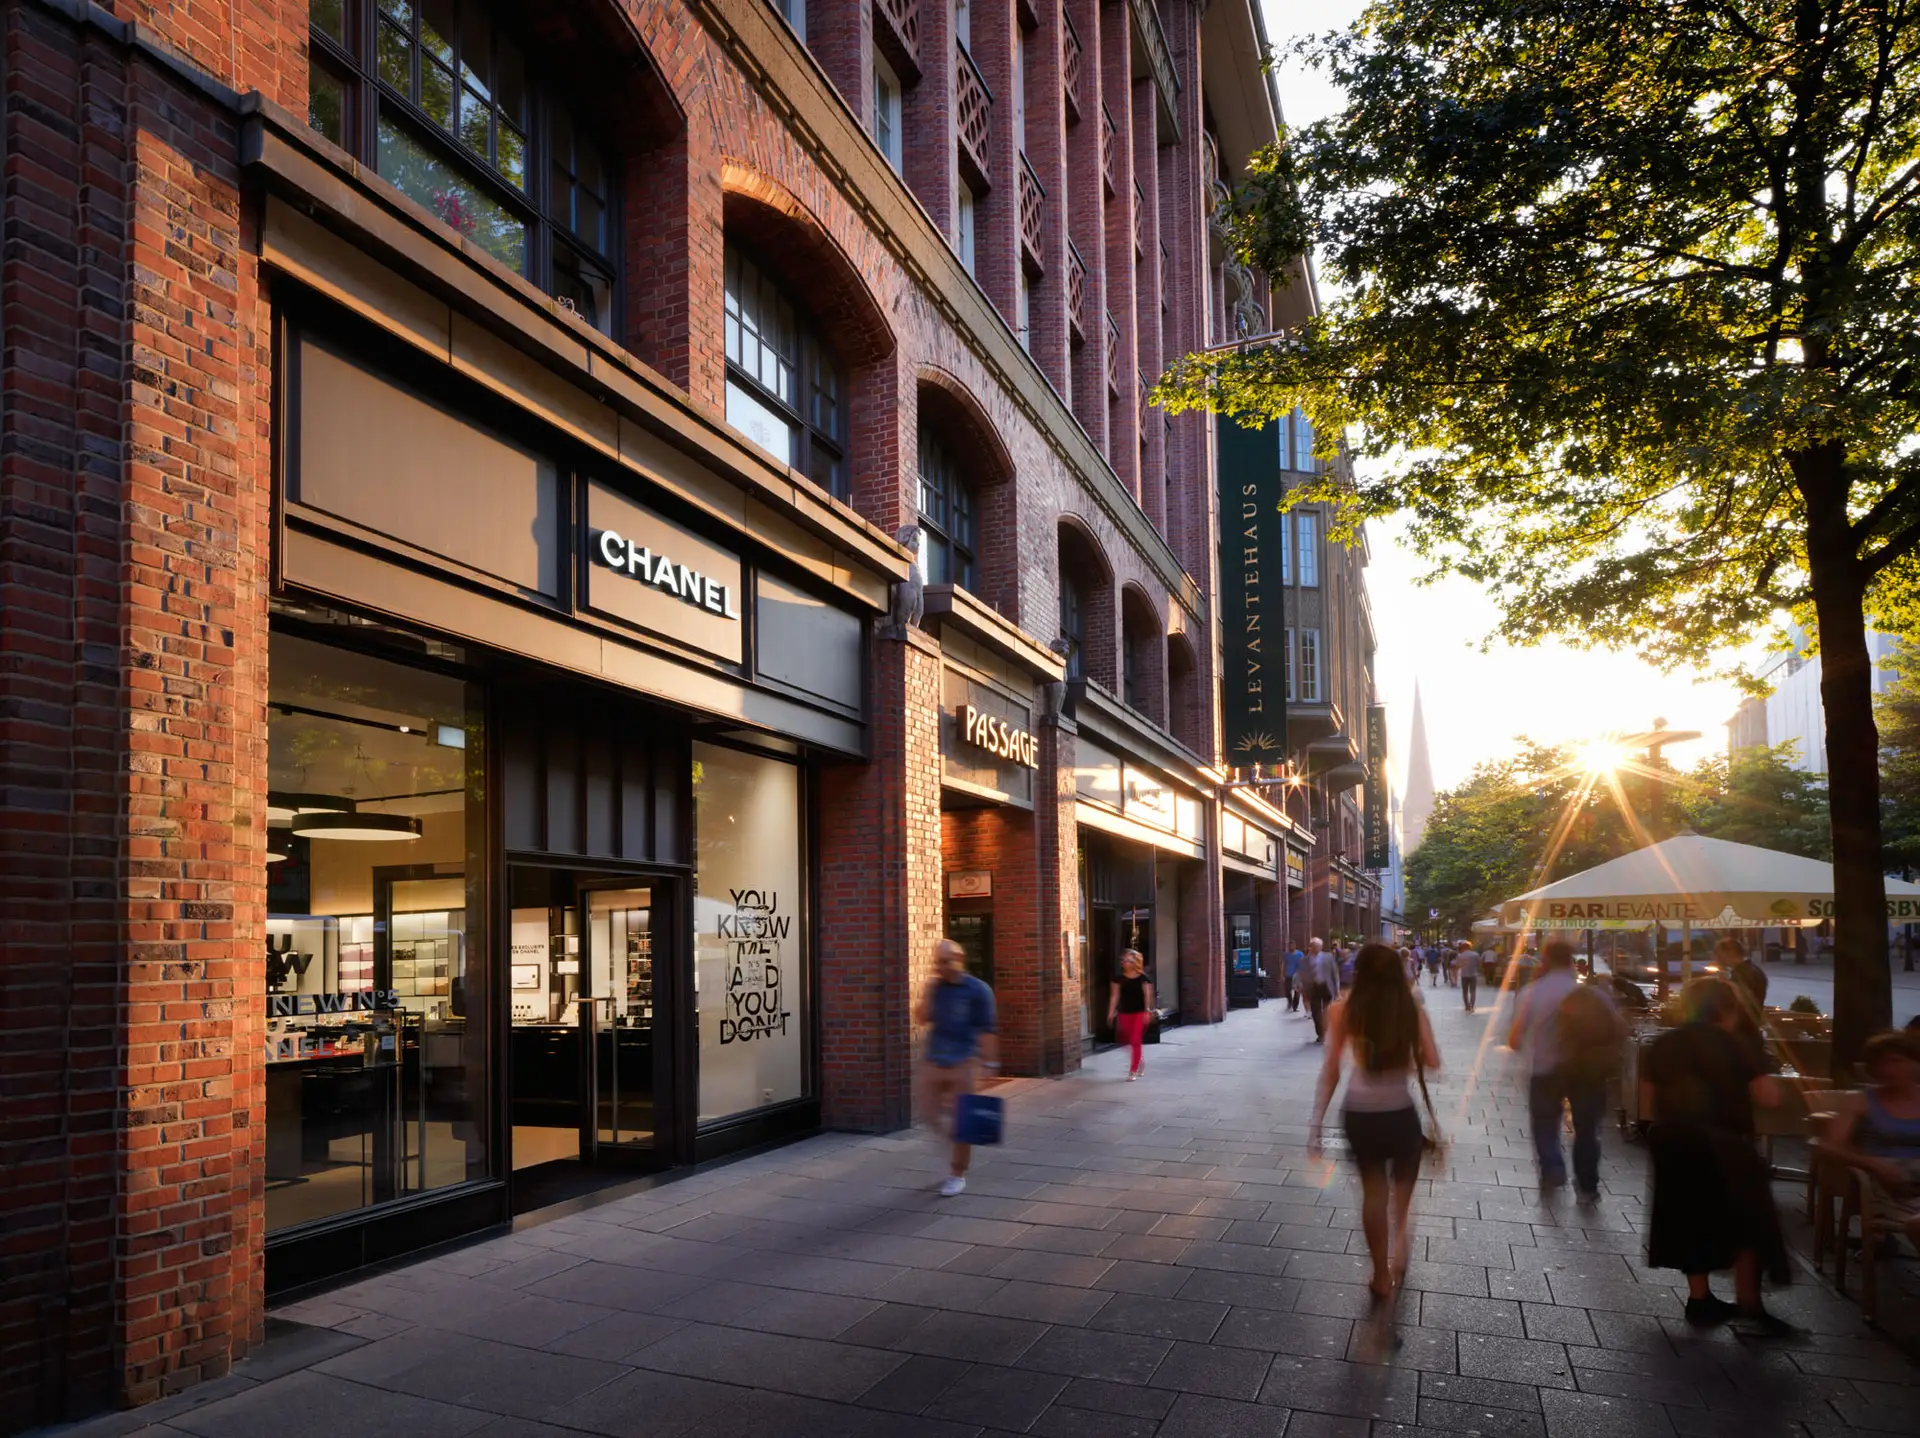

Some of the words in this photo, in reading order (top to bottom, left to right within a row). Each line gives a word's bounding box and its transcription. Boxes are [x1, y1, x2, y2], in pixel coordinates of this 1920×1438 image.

[600, 529, 739, 621] CHANEL
[1242, 483, 1263, 713] LEVANTEHAUS
[966, 704, 1039, 770] PASSAGE
[1371, 804, 1381, 859] HAMBURG
[729, 888, 776, 915] YOU
[729, 965, 779, 991] AD
[272, 993, 349, 1016] NEW
[730, 990, 778, 1017] YOU
[720, 1011, 791, 1045] DON'T
